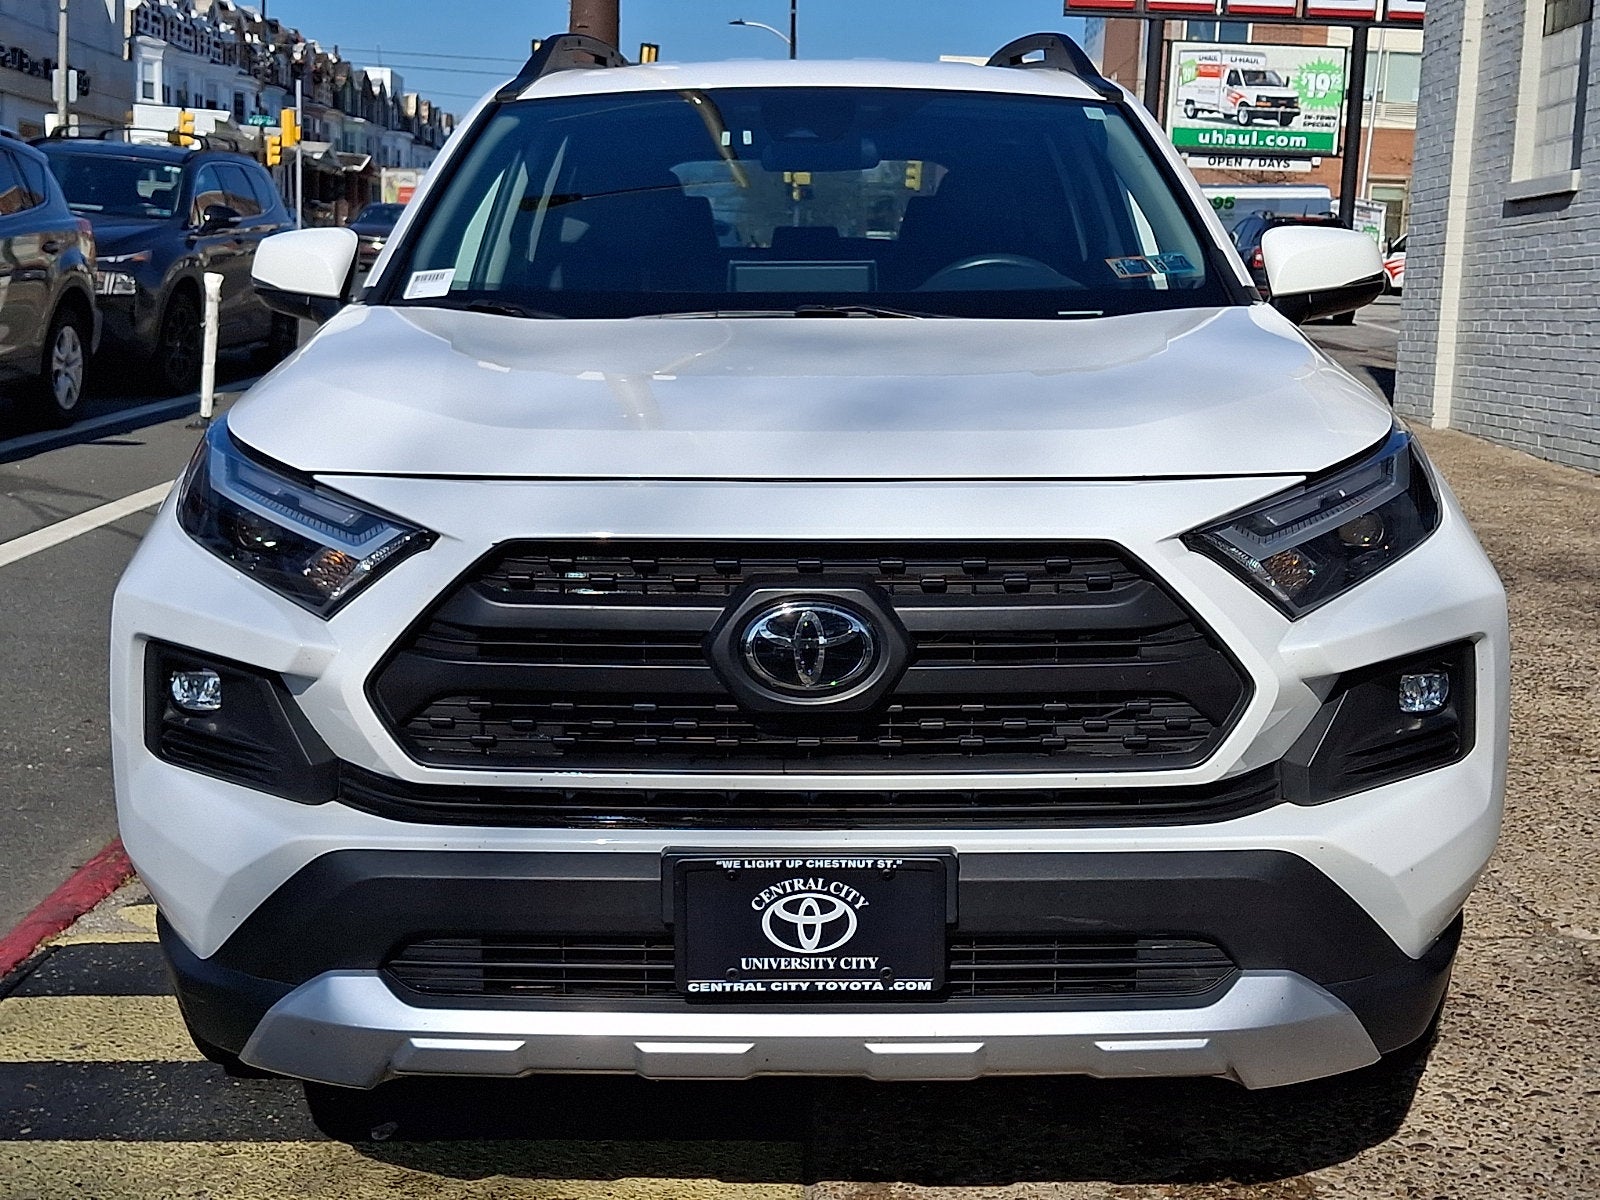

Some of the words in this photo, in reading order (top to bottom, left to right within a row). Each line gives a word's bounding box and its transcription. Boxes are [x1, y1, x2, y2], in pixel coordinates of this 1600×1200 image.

[1198, 130, 1307, 148] uhaul.com
[1207, 156, 1242, 168] OPEN
[1258, 158, 1291, 168] DAYS
[744, 860, 782, 869] LIGHT
[786, 860, 803, 869] UP
[806, 860, 874, 869] CHESTNUT
[751, 878, 827, 912] CENTRAL
[830, 881, 870, 910] CITY
[741, 957, 837, 970] UNIVERSITY
[840, 957, 879, 970] CITY
[688, 982, 768, 992] CENTRAL
[771, 982, 808, 992] CITY
[814, 981, 885, 991] TOYOTA
[888, 981, 932, 991] .COM
